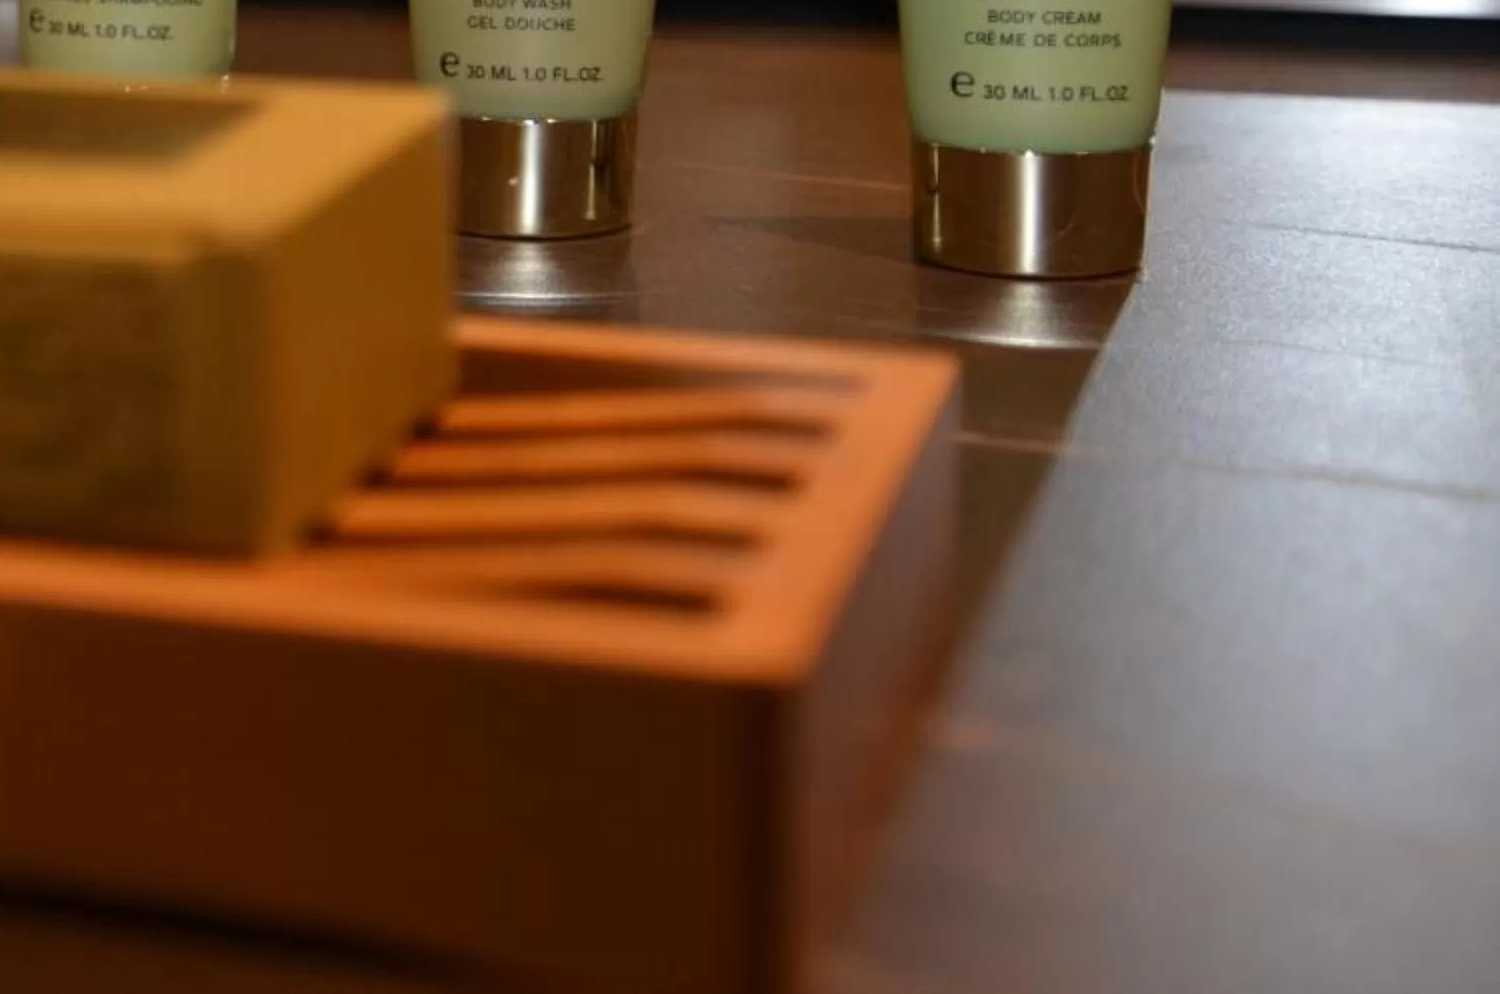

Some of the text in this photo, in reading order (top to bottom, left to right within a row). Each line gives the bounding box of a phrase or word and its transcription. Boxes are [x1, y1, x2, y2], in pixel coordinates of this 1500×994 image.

[504, 17, 577, 31] DOUCHE
[987, 9, 1102, 25] BODY CREAM
[1033, 33, 1057, 47] DE
[1064, 33, 1122, 48] CORPS
[467, 65, 485, 79] 30
[491, 66, 516, 81] ML
[983, 85, 1006, 100] 30
[1012, 85, 1042, 101] ML
